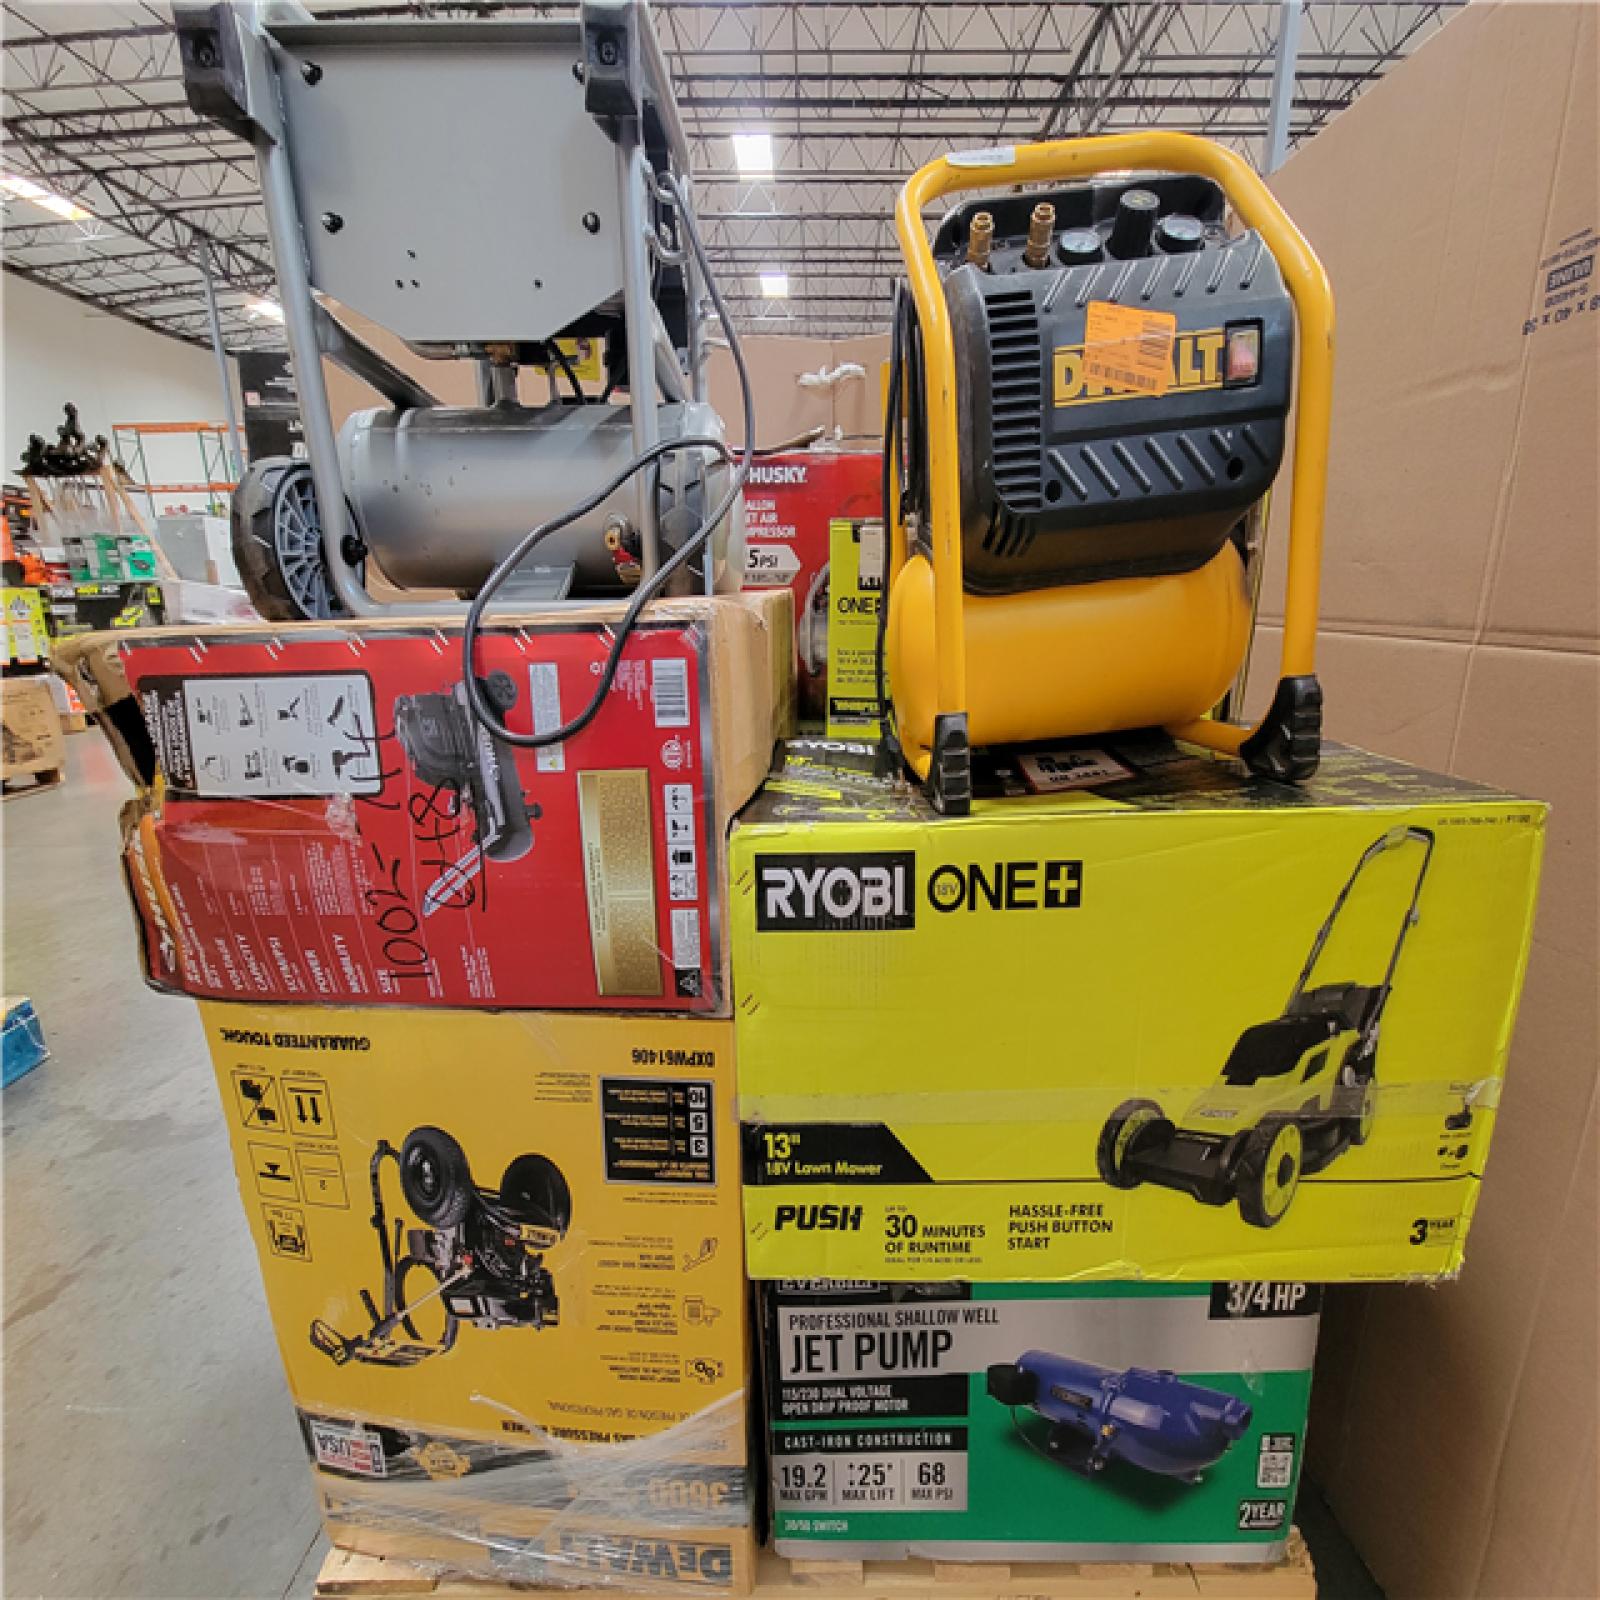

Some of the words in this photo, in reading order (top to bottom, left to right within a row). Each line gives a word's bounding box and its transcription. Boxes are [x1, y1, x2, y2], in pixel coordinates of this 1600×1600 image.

[1054, 334, 1225, 401] DLT
[750, 467, 807, 483] HUSKY
[747, 550, 760, 568] 5
[762, 866, 909, 918] RYOBI
[236, 933, 268, 992] CAPACITY
[306, 950, 328, 993] POWER
[332, 933, 361, 993] MOBILITY
[378, 970, 392, 993] SIZE
[273, 1033, 370, 1050] GUARANTEED
[632, 1048, 715, 1068] DXPW61406
[689, 1090, 705, 1104] 10
[693, 1115, 703, 1129] 5
[694, 1140, 704, 1153] 3
[767, 1161, 790, 1175] 18V
[795, 1161, 831, 1175] Lawn
[835, 1161, 882, 1175] Mower
[775, 1205, 863, 1230] PUSH
[1009, 1204, 1103, 1218] HASSLE-FREE
[885, 1215, 917, 1238] 30
[922, 1225, 985, 1238] MINUTES
[1008, 1220, 1048, 1233] PUSH
[1052, 1220, 1113, 1233] BUTTON
[1409, 1219, 1428, 1245] 3
[1429, 1219, 1455, 1229] YEAR
[885, 1241, 904, 1253] OF
[908, 1241, 971, 1253] RUNTIME
[1008, 1237, 1050, 1250] START
[1226, 1280, 1271, 1312] 3/4
[1274, 1282, 1306, 1311] HP
[789, 1311, 890, 1330] PROFESSIONAL
[894, 1309, 958, 1326] SHALLOW
[963, 1307, 999, 1324] WELL
[790, 1334, 844, 1374] JET
[855, 1330, 953, 1371] PUMP
[822, 1386, 847, 1399] DUAL
[849, 1384, 891, 1398] VOLTAGE
[782, 1401, 809, 1416] OPEN
[811, 1400, 836, 1414] DRIP
[837, 1399, 872, 1412] PROOF
[874, 1398, 910, 1411] MOTOR
[317, 1433, 350, 1456] USA
[784, 1434, 851, 1449] CAST-IRON
[856, 1432, 951, 1447] CONSTRUCTION
[781, 1463, 826, 1488] 19.2
[918, 1462, 946, 1486] 68
[780, 1489, 801, 1501] MAX
[804, 1489, 828, 1501] GPM
[842, 1489, 865, 1501] MAX
[869, 1488, 895, 1500] LIFT
[911, 1488, 932, 1500] MAX
[934, 1488, 953, 1500] PSI
[812, 1519, 849, 1532] SWITCH
